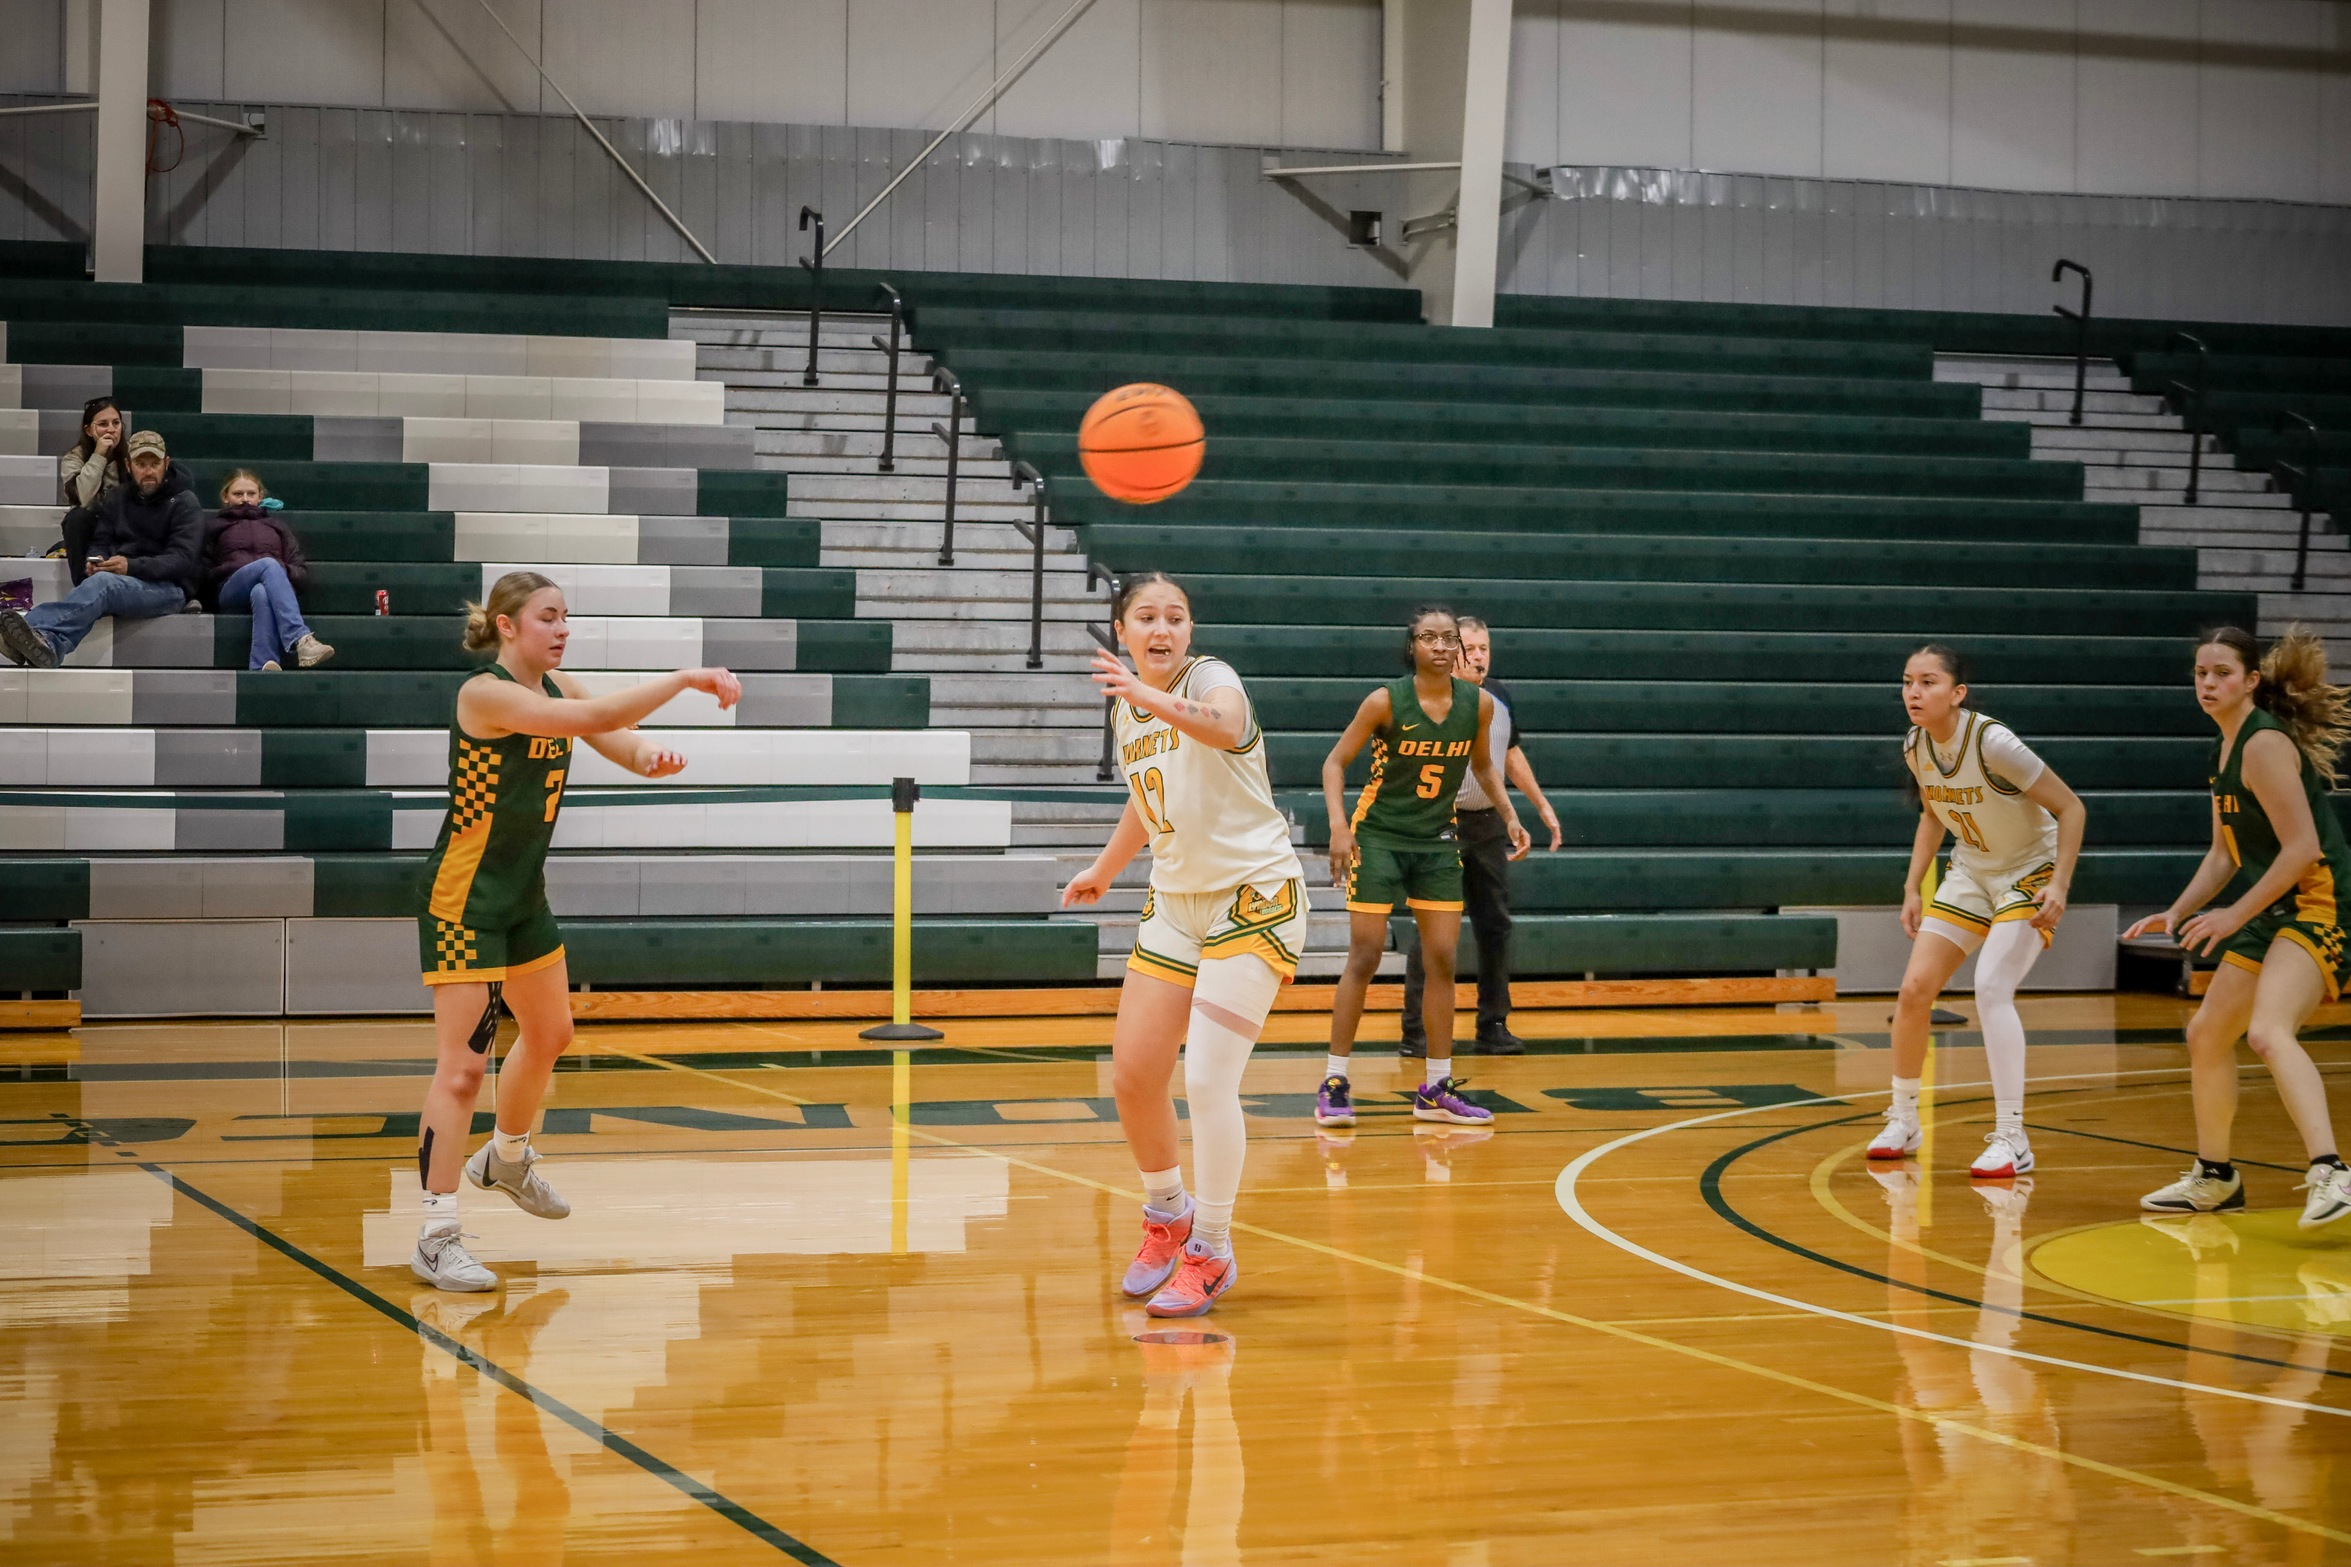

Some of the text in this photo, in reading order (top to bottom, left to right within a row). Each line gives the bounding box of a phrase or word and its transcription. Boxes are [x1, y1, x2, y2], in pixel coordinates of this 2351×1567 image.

[1398, 740, 1471, 757] DELHI
[1416, 764, 1445, 799] 5
[1129, 767, 1175, 834] 12
